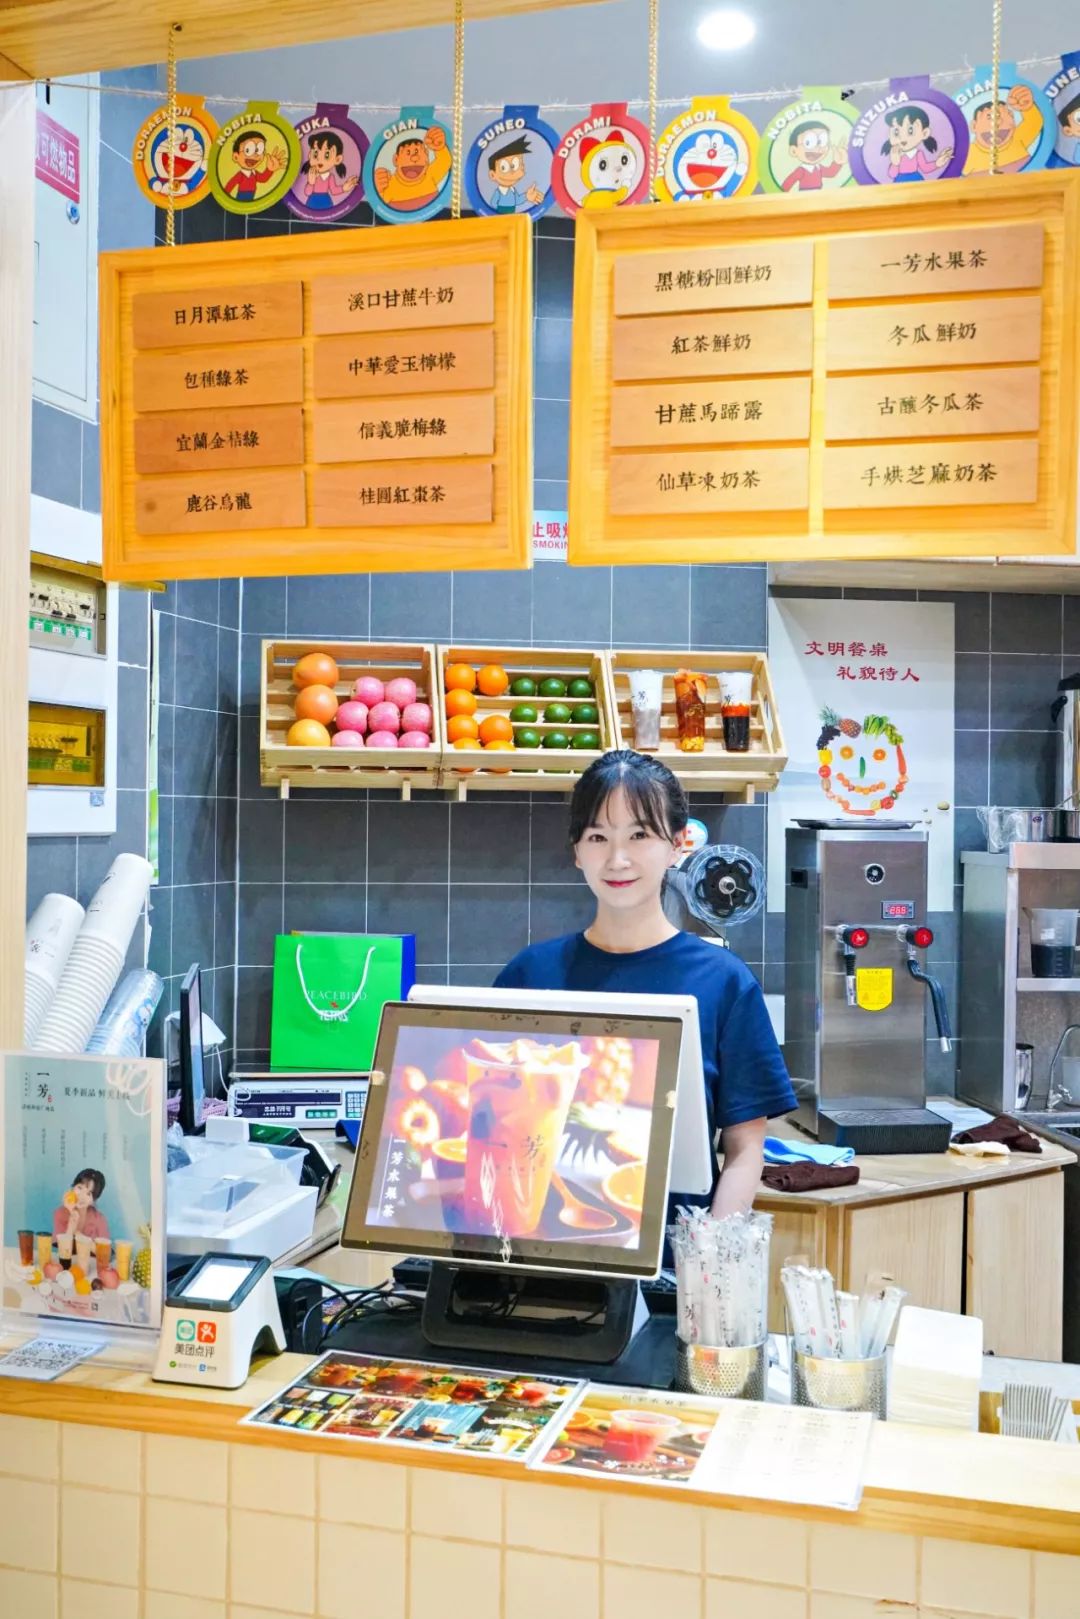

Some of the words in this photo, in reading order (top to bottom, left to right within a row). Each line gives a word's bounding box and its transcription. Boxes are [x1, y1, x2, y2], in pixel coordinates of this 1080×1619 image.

[216, 113, 262, 146] NOBITA
[383, 117, 418, 140] GIAN
[768, 101, 822, 139] NOBITA
[852, 91, 909, 148] SHIZUKA
[477, 117, 525, 150] SUNEO
[558, 115, 611, 159] DORAMI
[36, 132, 76, 185] 可燃物品
[880, 248, 989, 274] 一芳水果茶
[654, 264, 772, 293] 黑糖粉圓鮮奶
[347, 286, 455, 312] 溪口甘蔗牛奶
[174, 303, 257, 326] 日月潭紅茶
[670, 333, 752, 355] 紅茶鮮奶
[888, 322, 978, 347] 冬瓜鮮奶
[348, 351, 457, 377] 中華愛玉檸檬
[184, 368, 249, 390] 包種綠茶
[655, 399, 763, 426] 甘蔗馬蹄露
[877, 392, 985, 416] 古釀冬瓜茶
[176, 430, 260, 452] 宜蘭金桔綠
[358, 417, 448, 441] 信義脆梅綠
[656, 469, 761, 493] 仙草凍奶茶
[860, 462, 999, 488] 手烘芝麻奶茶
[185, 491, 253, 513] 鹿谷烏龍
[359, 485, 447, 506] 桂圓紅棗茶
[804, 641, 889, 657] 文明餐桌
[836, 666, 921, 682] 礼貌待人
[382, 1138, 407, 1218] 一芳水果茶
[174, 1343, 215, 1358] 美团点评
